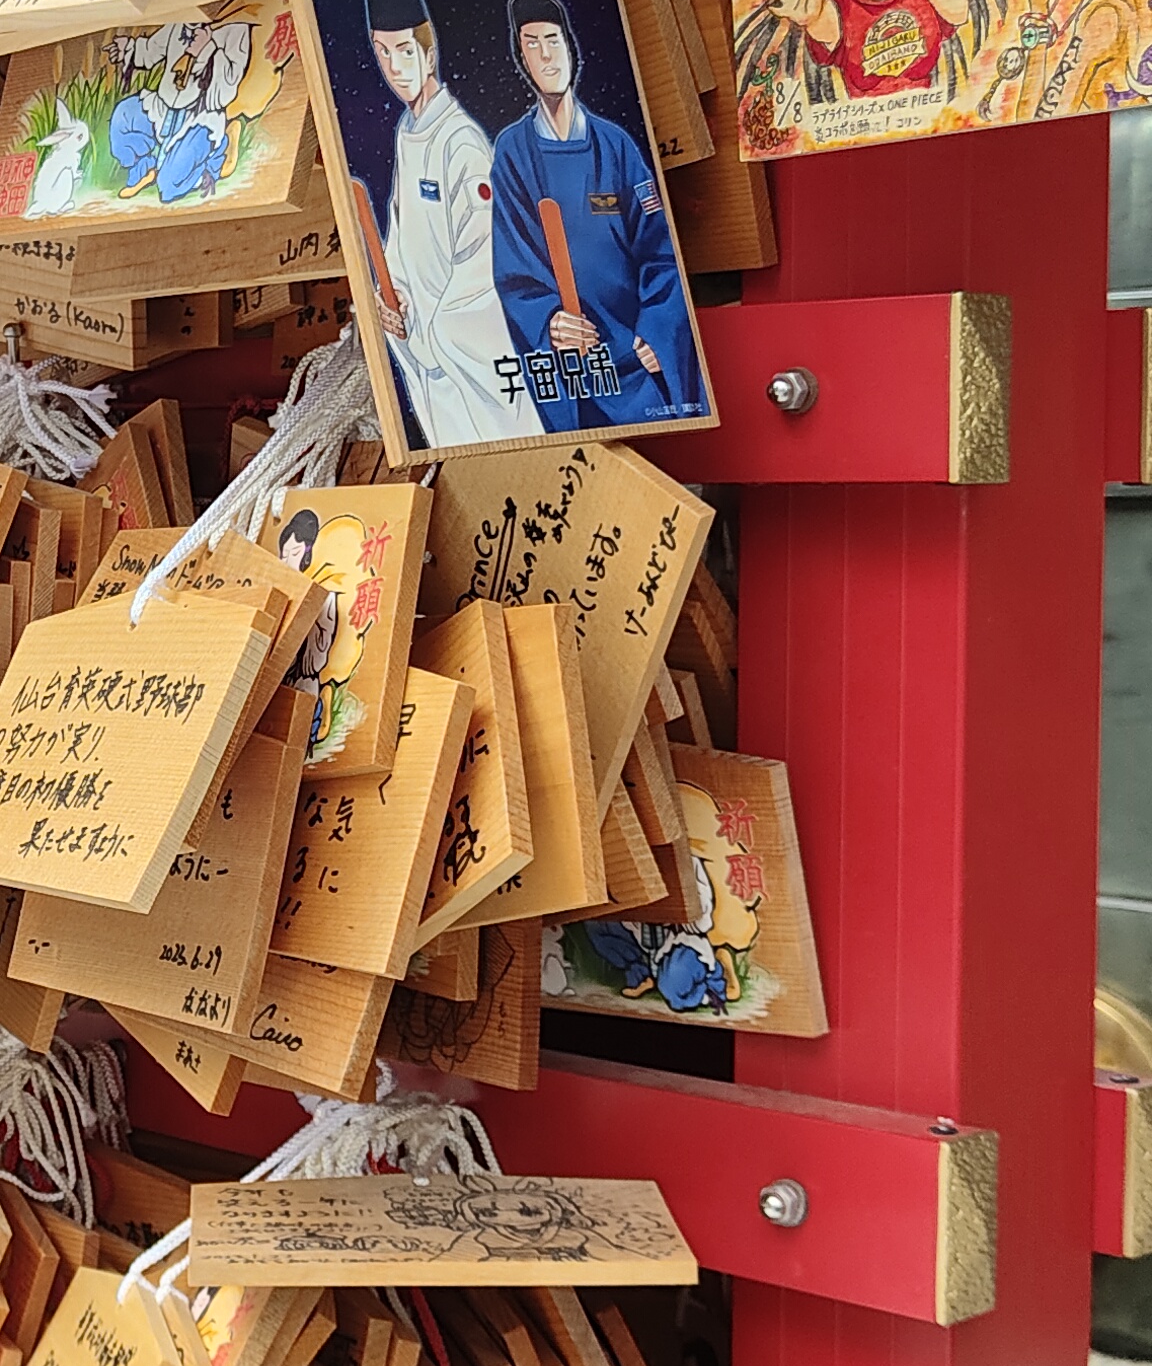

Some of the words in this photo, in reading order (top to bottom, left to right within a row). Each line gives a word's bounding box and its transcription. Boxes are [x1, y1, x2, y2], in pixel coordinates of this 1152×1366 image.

[493, 342, 622, 405] 宇宙兄弟
[348, 520, 393, 630] 祈願
[714, 797, 770, 902] 祈願
